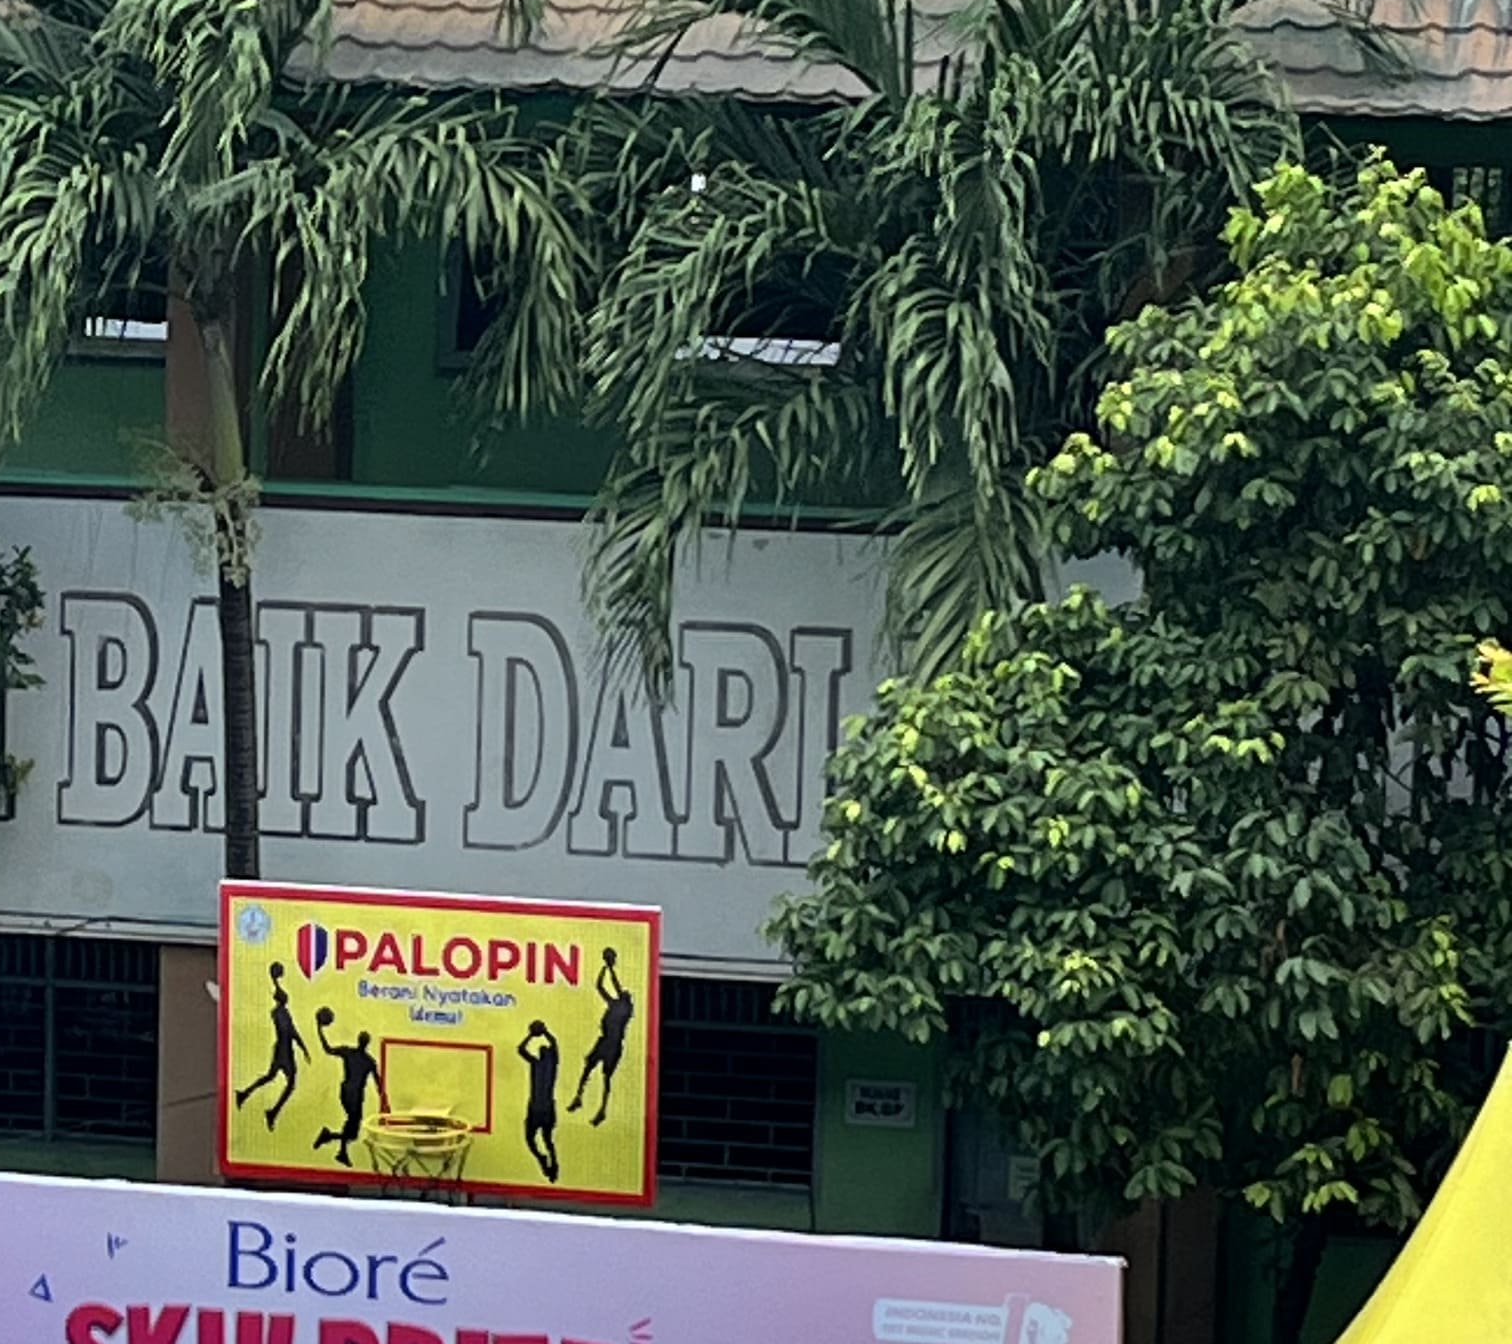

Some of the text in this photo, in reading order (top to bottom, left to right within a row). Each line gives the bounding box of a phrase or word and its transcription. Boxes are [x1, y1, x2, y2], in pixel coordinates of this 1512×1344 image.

[57, 590, 427, 844] BAIK
[463, 609, 852, 867] DARI
[334, 927, 582, 987] PALOPIN
[226, 1219, 450, 1306] Bioré
